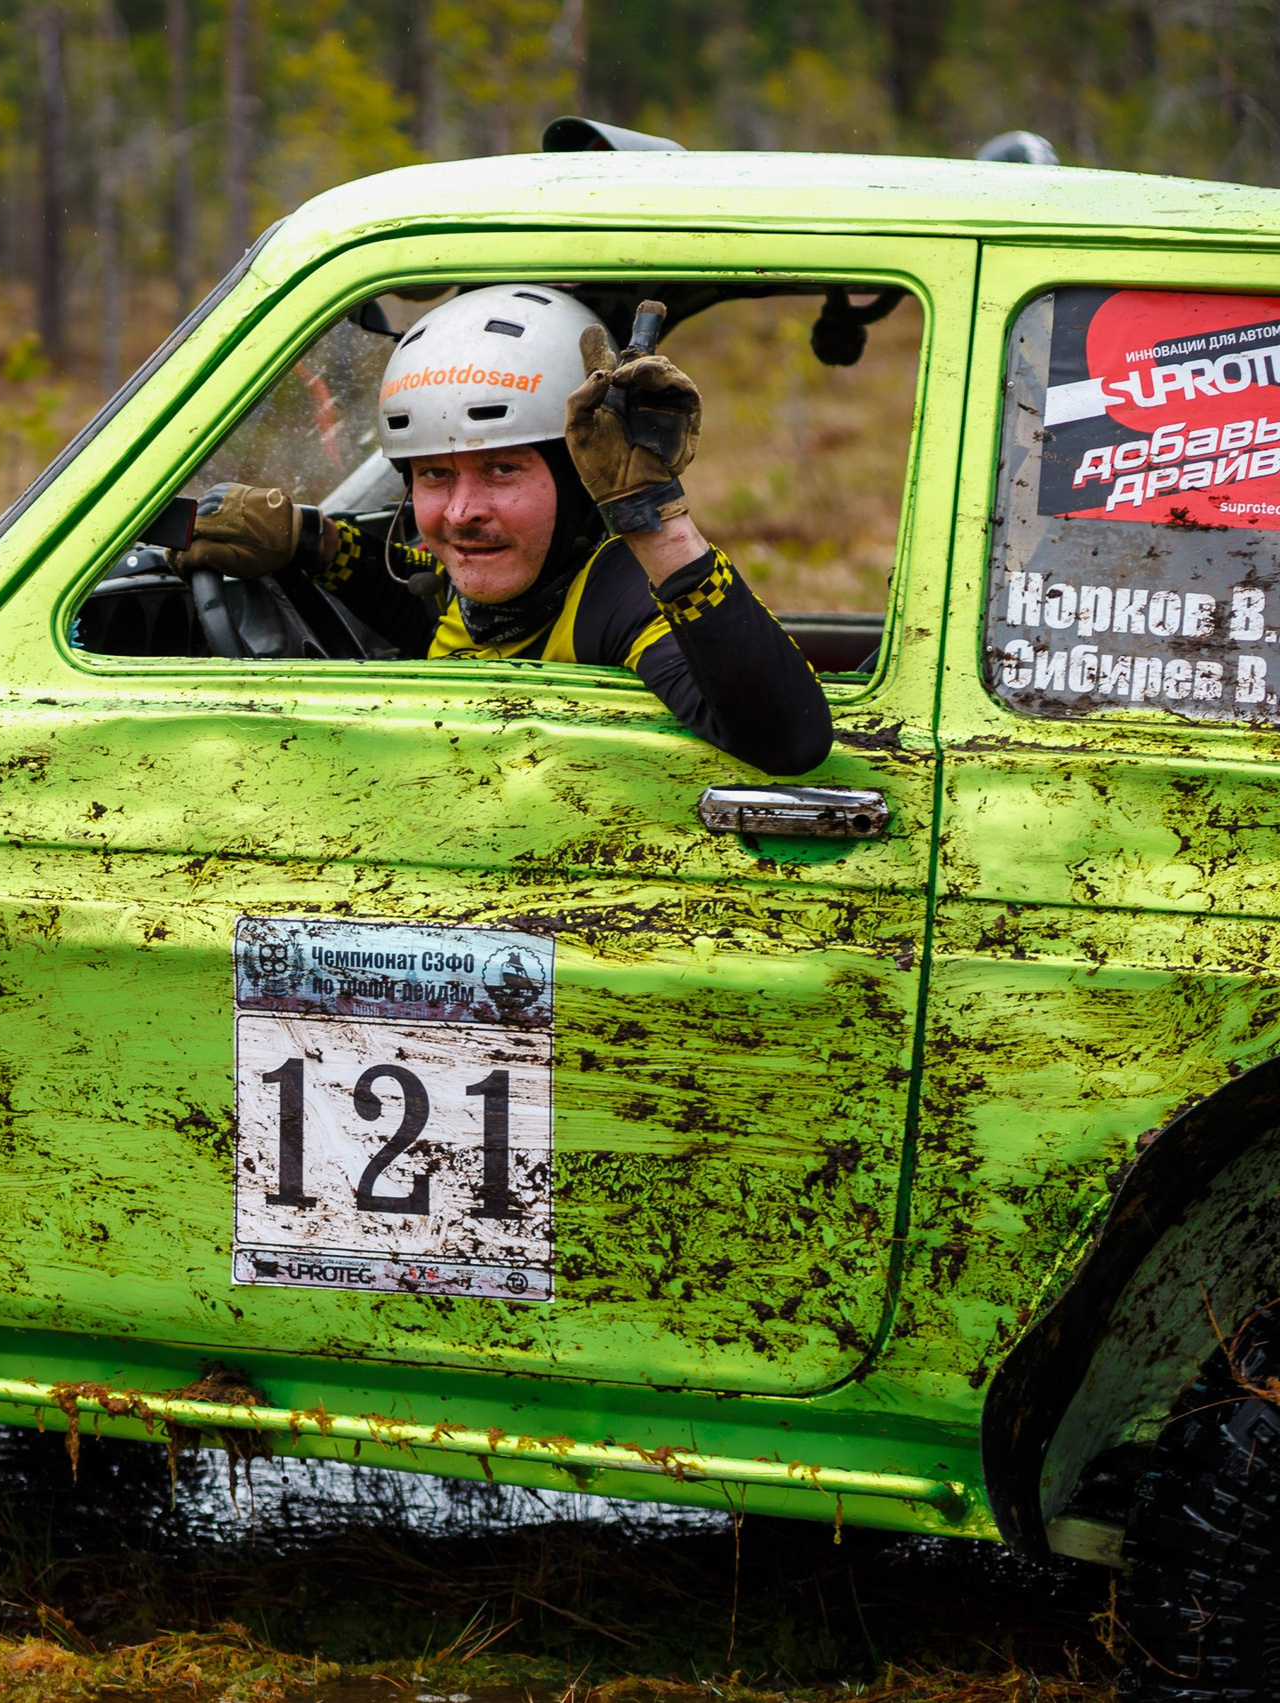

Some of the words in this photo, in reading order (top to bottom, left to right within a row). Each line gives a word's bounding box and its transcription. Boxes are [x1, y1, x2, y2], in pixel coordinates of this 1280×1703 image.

[1125, 338, 1207, 364] ИННОВАЦИИ
[1208, 331, 1237, 351] ДЛЯ
[1006, 571, 1217, 638] Норков
[1002, 639, 1224, 702] Сибирев
[311, 946, 418, 970] Чемпионат
[421, 950, 475, 974] СЗФО
[312, 975, 334, 995] по
[261, 1057, 534, 1221] 121
